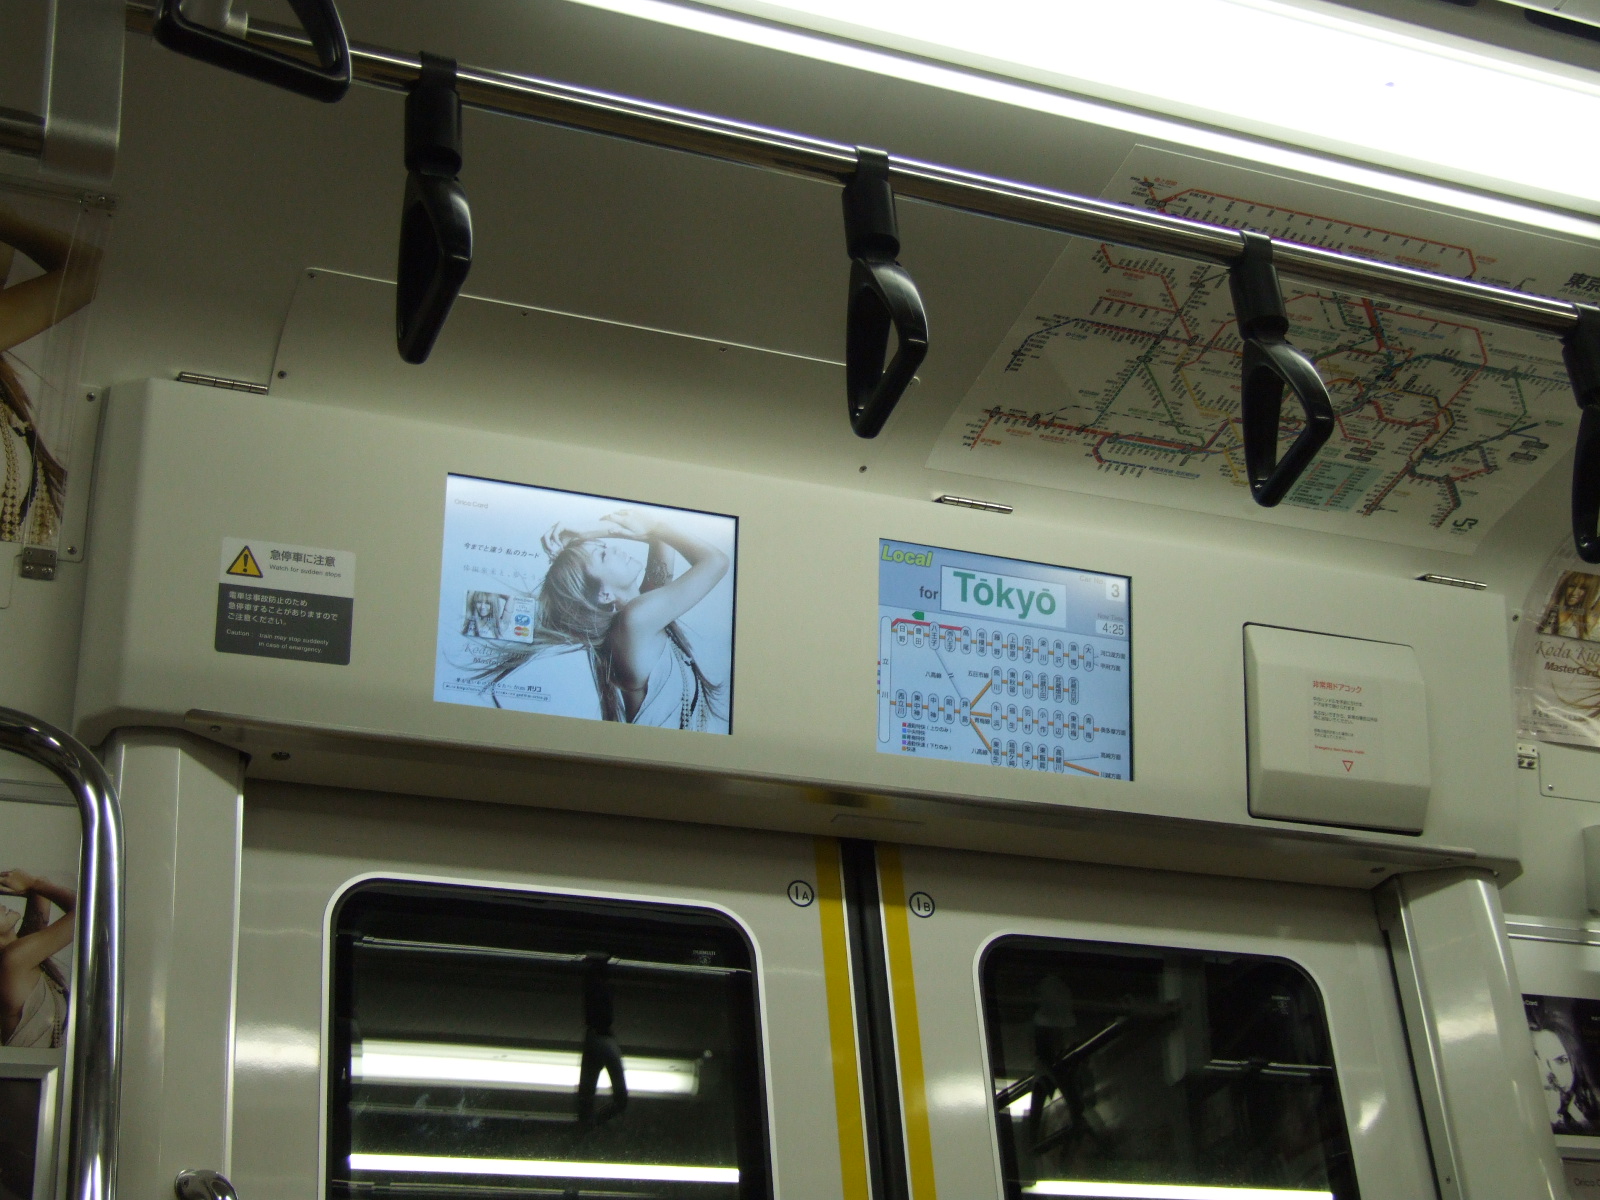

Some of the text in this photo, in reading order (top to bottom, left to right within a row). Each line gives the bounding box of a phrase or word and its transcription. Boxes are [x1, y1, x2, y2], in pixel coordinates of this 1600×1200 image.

[270, 549, 336, 567] 急停車に注意
[880, 544, 933, 567] Local
[269, 564, 289, 572] Watch
[919, 570, 1056, 620] for Tōkyō
[1111, 583, 1120, 598] 3
[229, 591, 308, 607] 電車は事故防止のため
[228, 602, 339, 621] 急停車することがありますので
[1102, 622, 1125, 636] 4:25
[303, 637, 329, 646] suddenly
[1312, 680, 1362, 694] 非常用ドアコック
